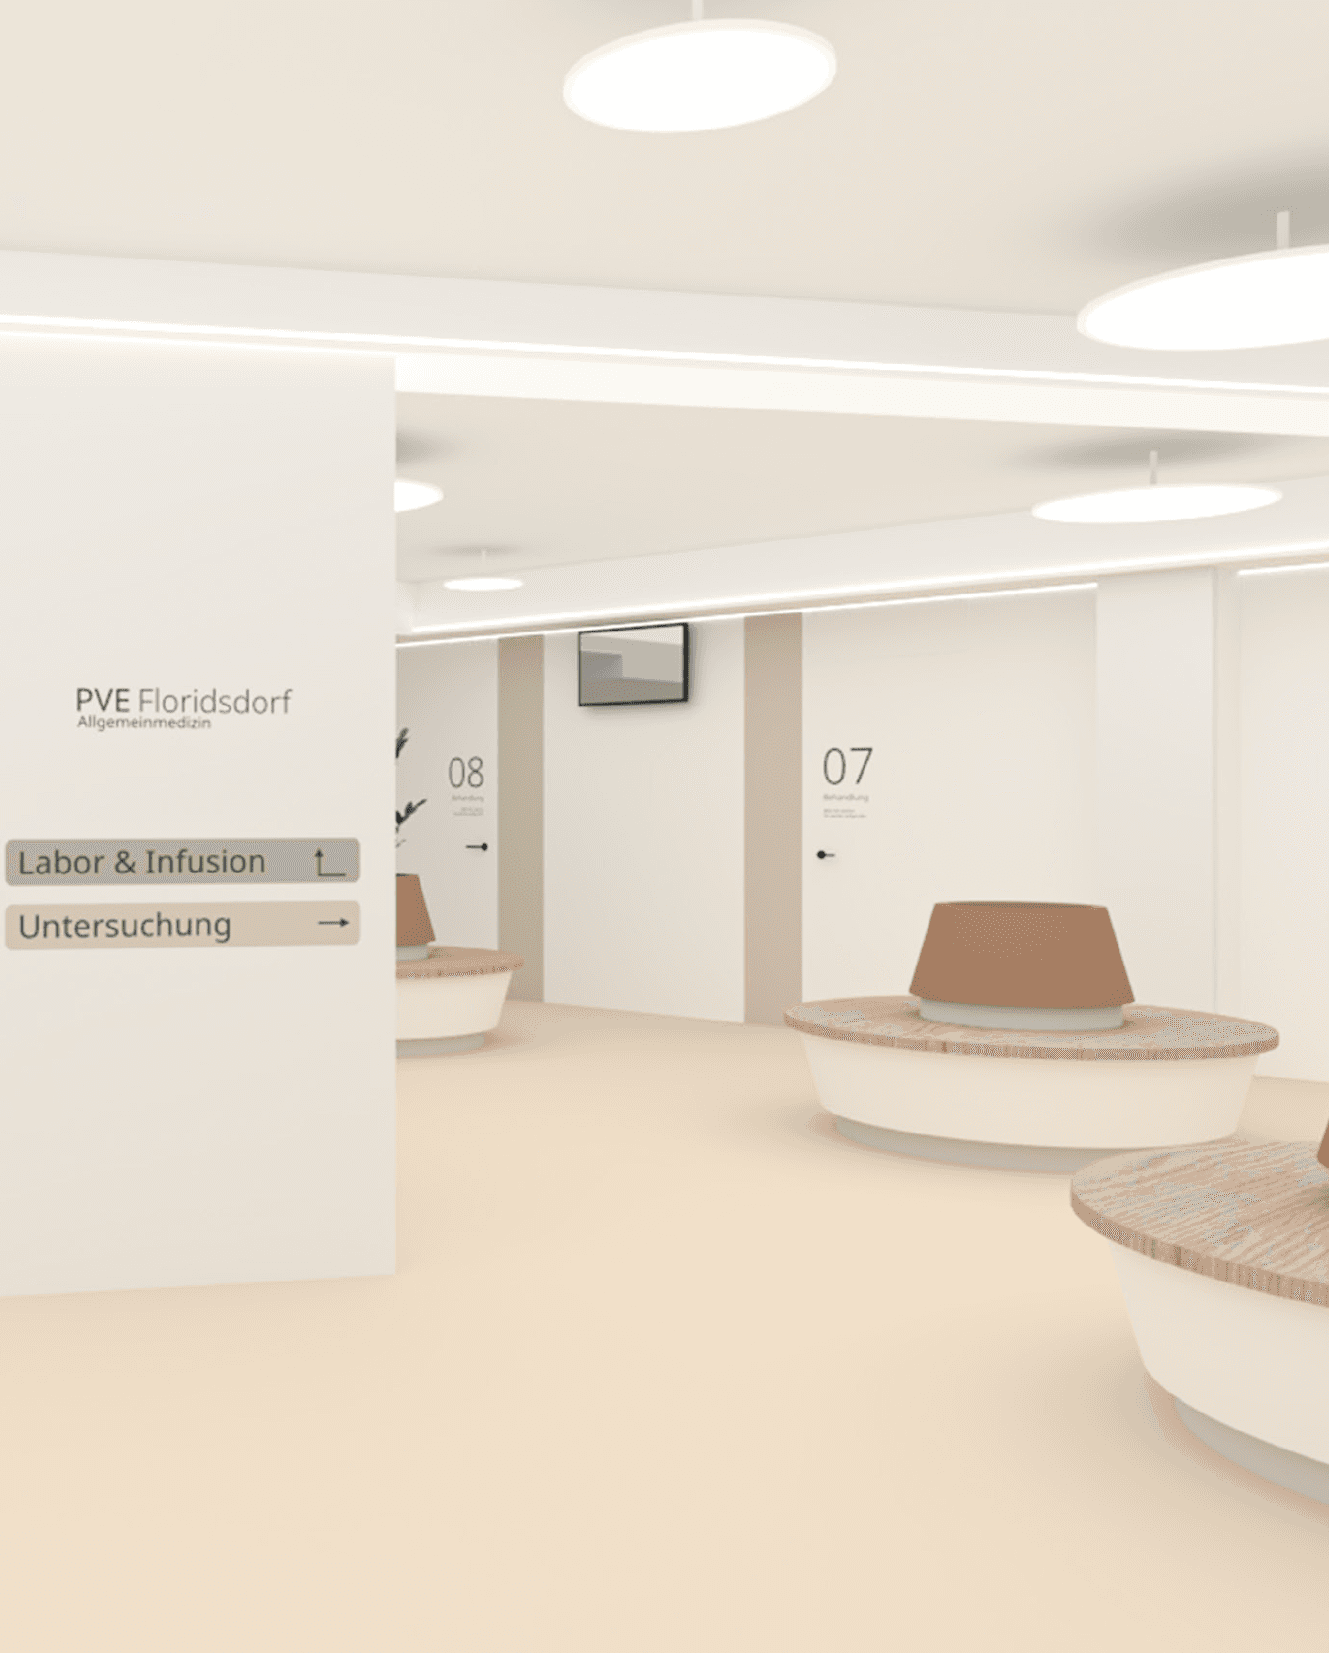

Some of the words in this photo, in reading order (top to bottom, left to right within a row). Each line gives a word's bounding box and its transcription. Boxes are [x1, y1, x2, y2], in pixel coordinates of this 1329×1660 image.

[76, 687, 130, 713] PVE
[139, 686, 293, 715] Floridsdorf
[77, 715, 212, 732] Allgemeinmedizin
[448, 755, 484, 788] 08
[823, 747, 873, 785] 07
[19, 849, 105, 875] Labor
[114, 850, 137, 875] &
[145, 848, 266, 874] Infusion
[19, 911, 232, 944] Untersuchung
